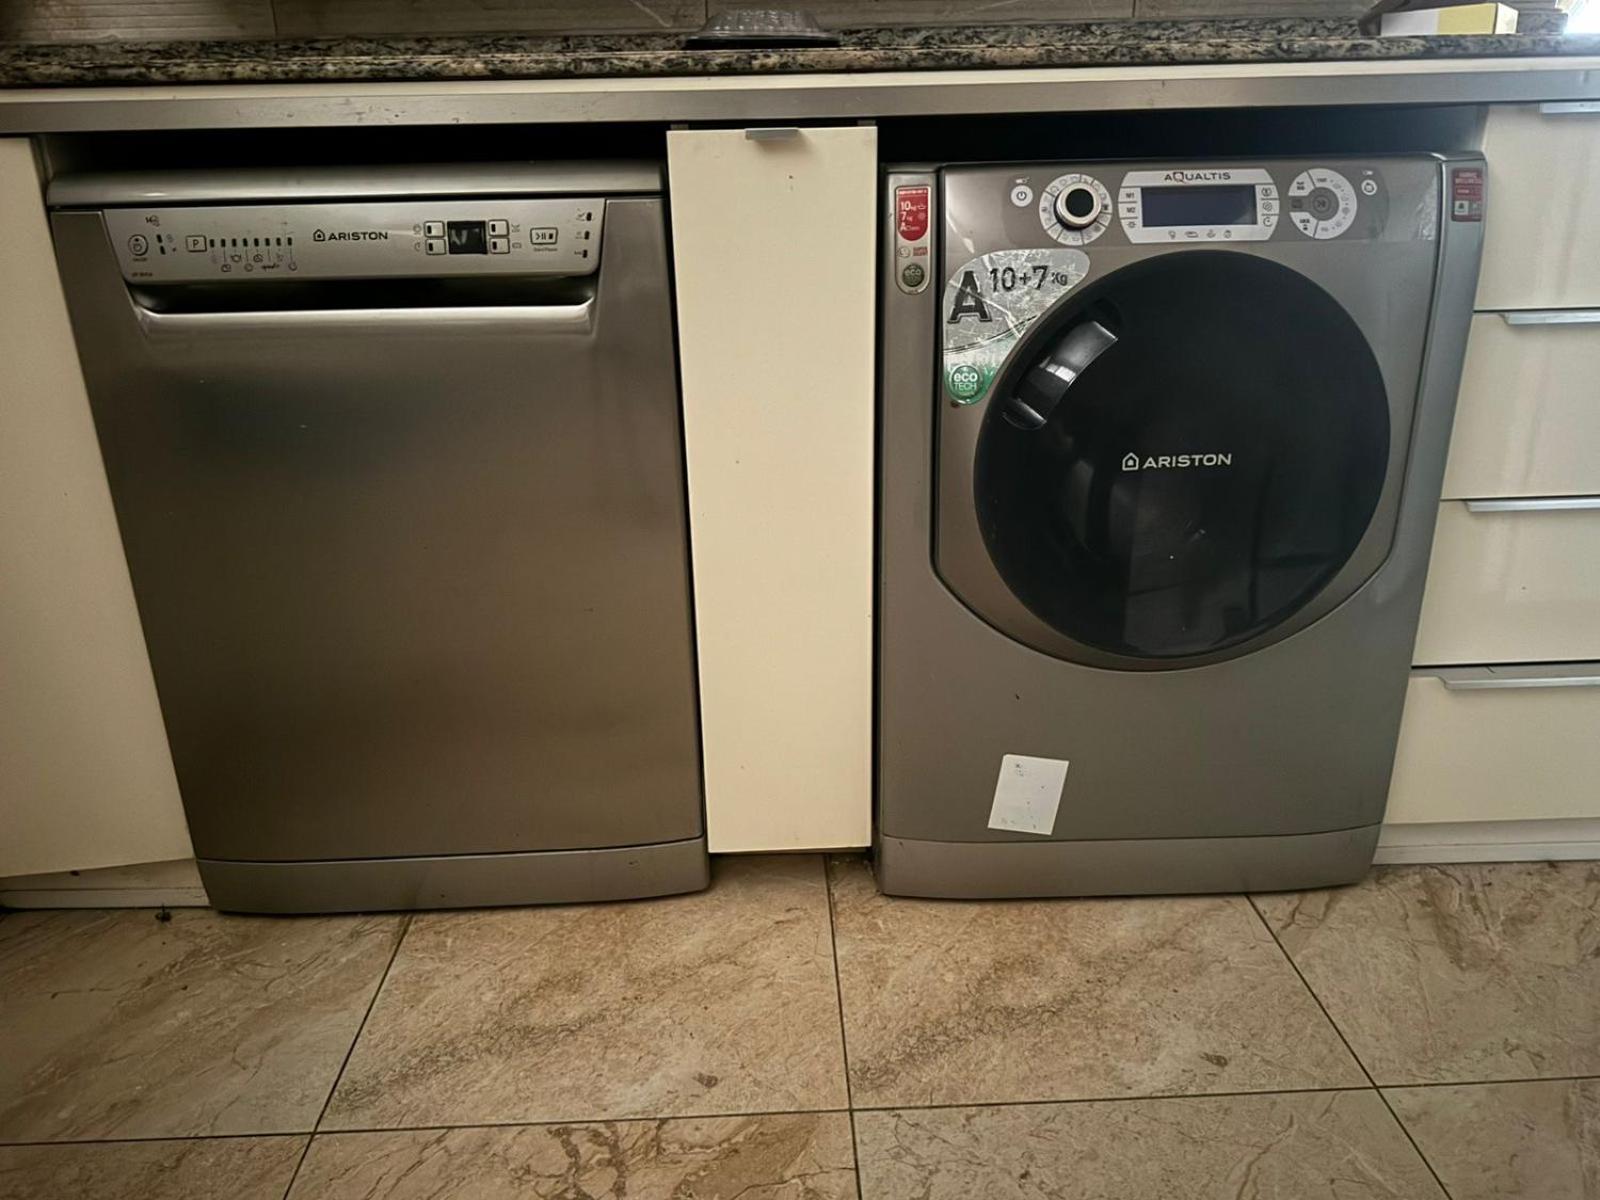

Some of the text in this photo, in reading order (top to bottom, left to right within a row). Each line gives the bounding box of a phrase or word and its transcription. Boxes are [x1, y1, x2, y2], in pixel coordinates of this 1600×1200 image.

[1164, 171, 1231, 183] AQUALTIS
[328, 231, 388, 241] ARISTON
[947, 270, 992, 323] A
[953, 372, 978, 382] eco
[953, 382, 977, 391] TECH
[1142, 453, 1232, 469] ARISTON
